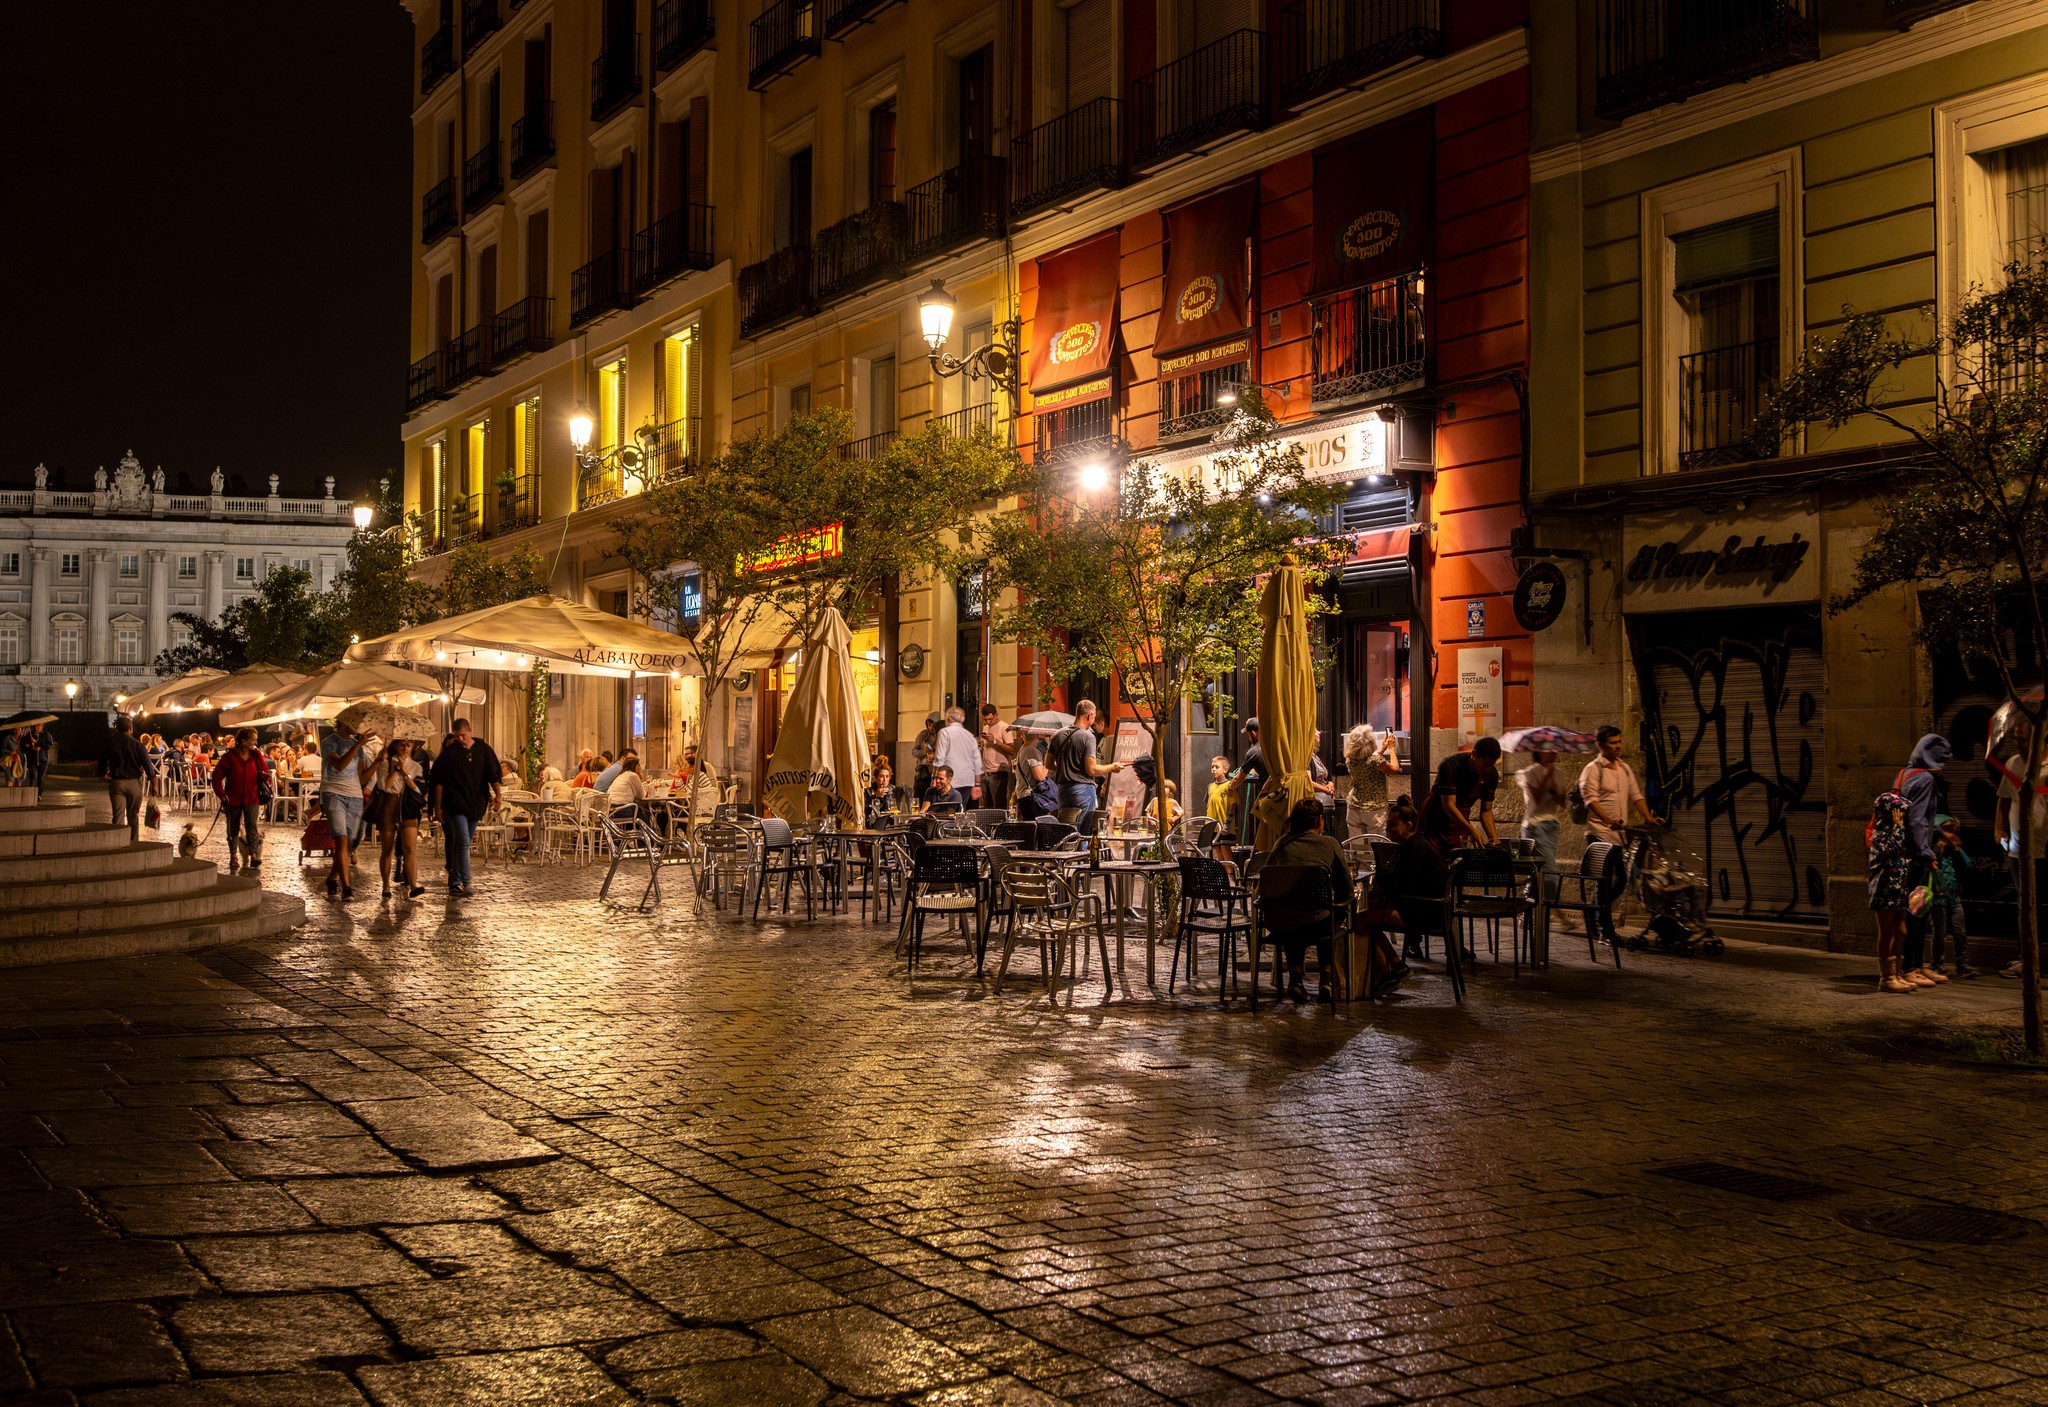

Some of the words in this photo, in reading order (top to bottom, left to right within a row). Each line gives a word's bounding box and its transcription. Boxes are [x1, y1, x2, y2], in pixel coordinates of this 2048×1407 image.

[1342, 230, 1398, 260] MONTADITOS
[1627, 545, 1657, 581] El
[1651, 541, 1719, 580] Perro
[1715, 533, 1810, 582] Salvaje
[573, 648, 687, 671] ALABARDERO
[809, 772, 832, 788] 100
